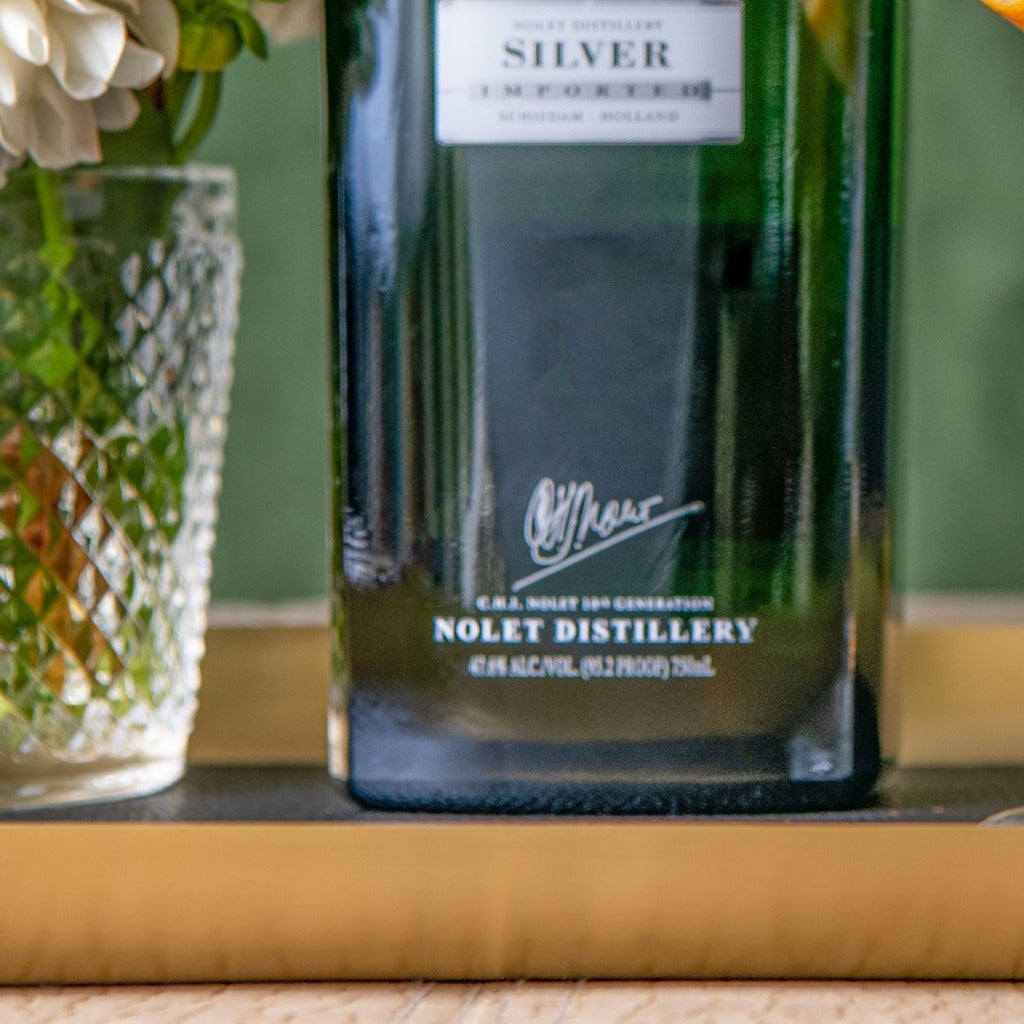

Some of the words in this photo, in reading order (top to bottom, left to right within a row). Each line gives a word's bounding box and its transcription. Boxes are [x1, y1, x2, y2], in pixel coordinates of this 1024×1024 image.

[503, 39, 672, 69] SILVER
[479, 83, 704, 98] IMPORTED
[433, 617, 544, 644] NOLET
[553, 617, 757, 644] DISTILLERY
